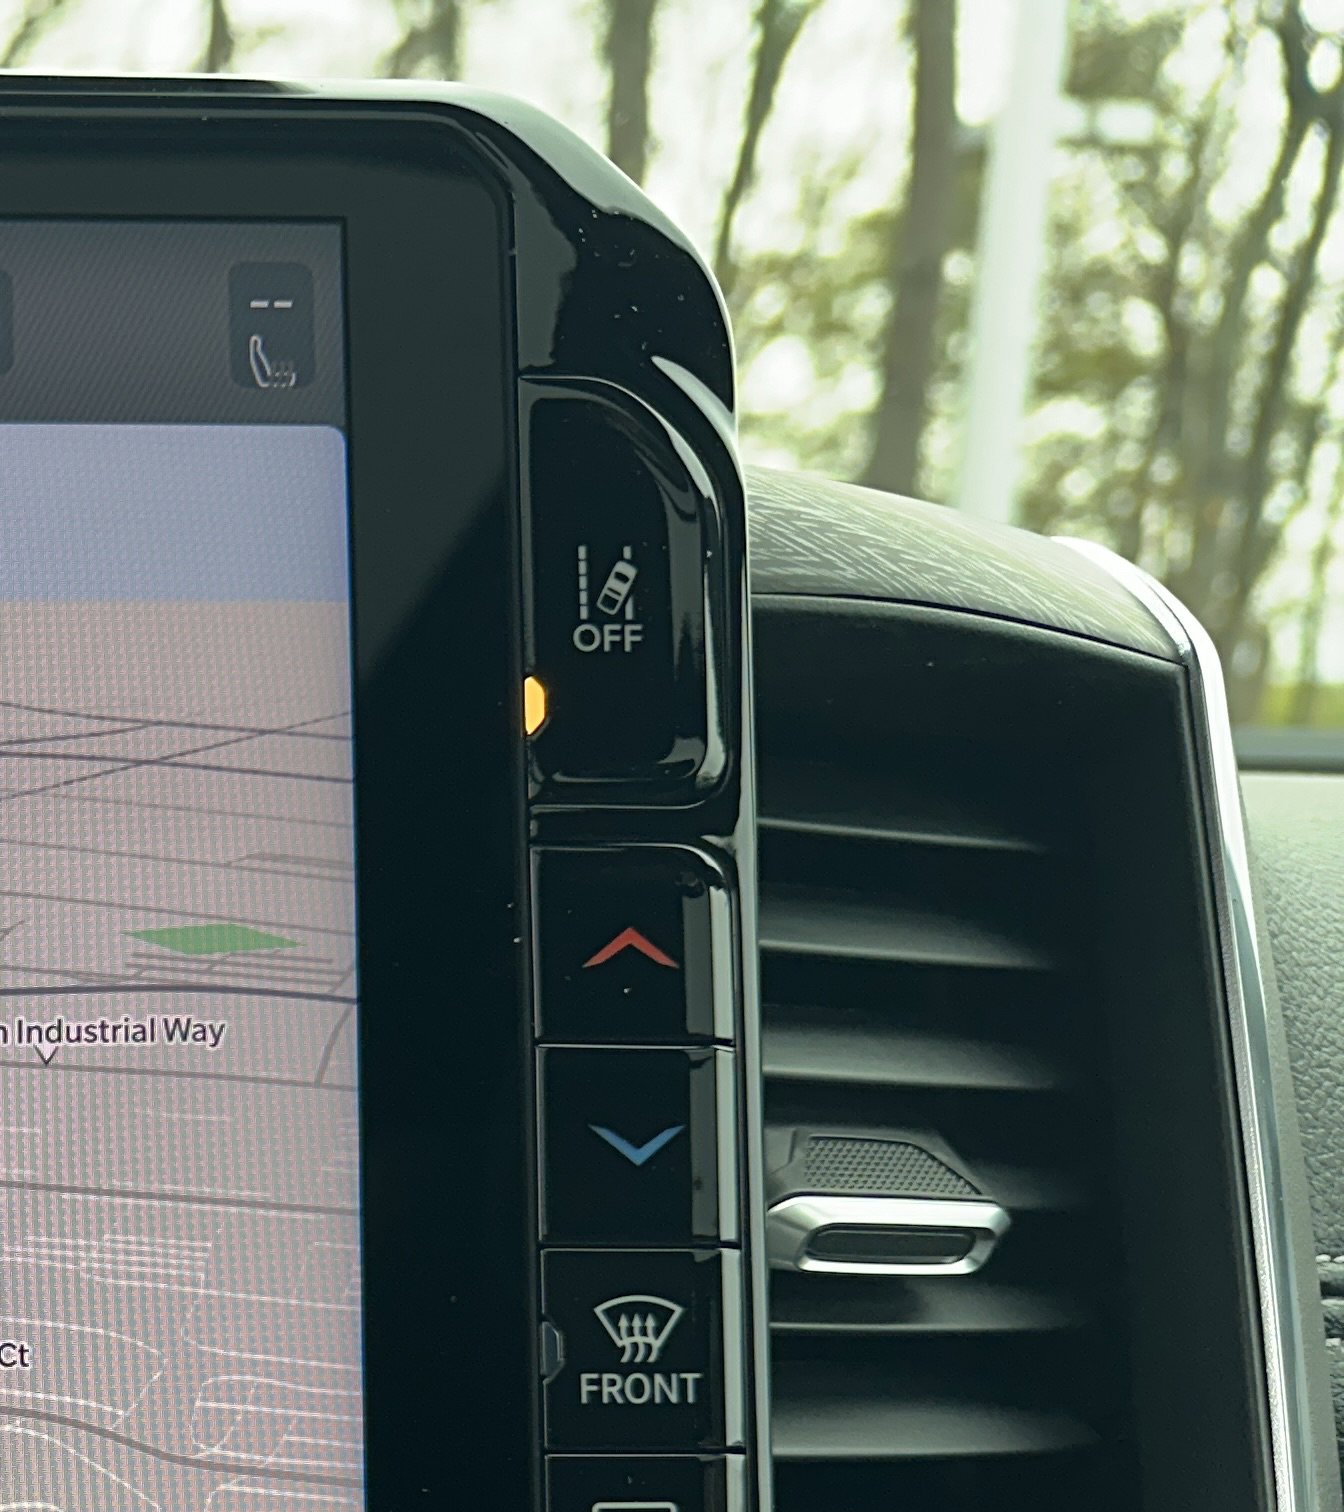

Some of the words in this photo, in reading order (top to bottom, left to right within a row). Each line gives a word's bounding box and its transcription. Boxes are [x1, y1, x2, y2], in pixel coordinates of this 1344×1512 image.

[573, 623, 643, 652] OFF
[16, 1018, 156, 1046] Industrial
[163, 1018, 226, 1050] Way
[580, 1372, 703, 1404] FRONT
